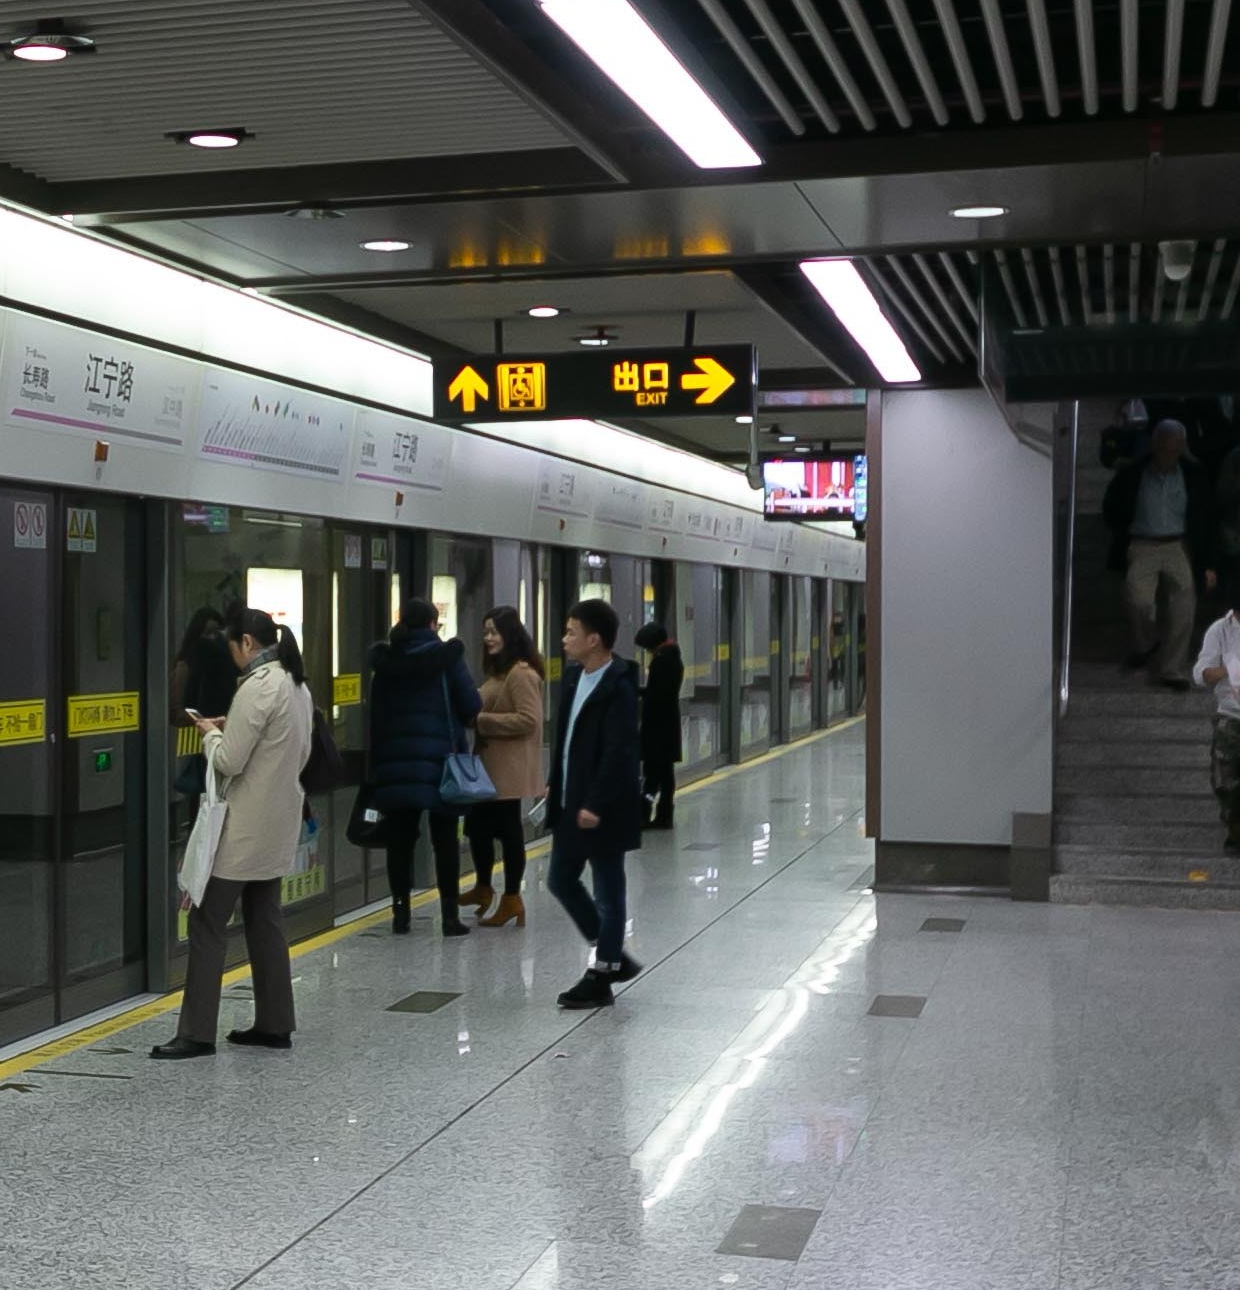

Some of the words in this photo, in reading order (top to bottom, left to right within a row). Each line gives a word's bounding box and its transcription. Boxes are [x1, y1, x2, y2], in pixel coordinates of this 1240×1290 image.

[85, 353, 134, 402] 江宁路
[614, 361, 668, 391] 出口
[636, 392, 668, 406] EXIT
